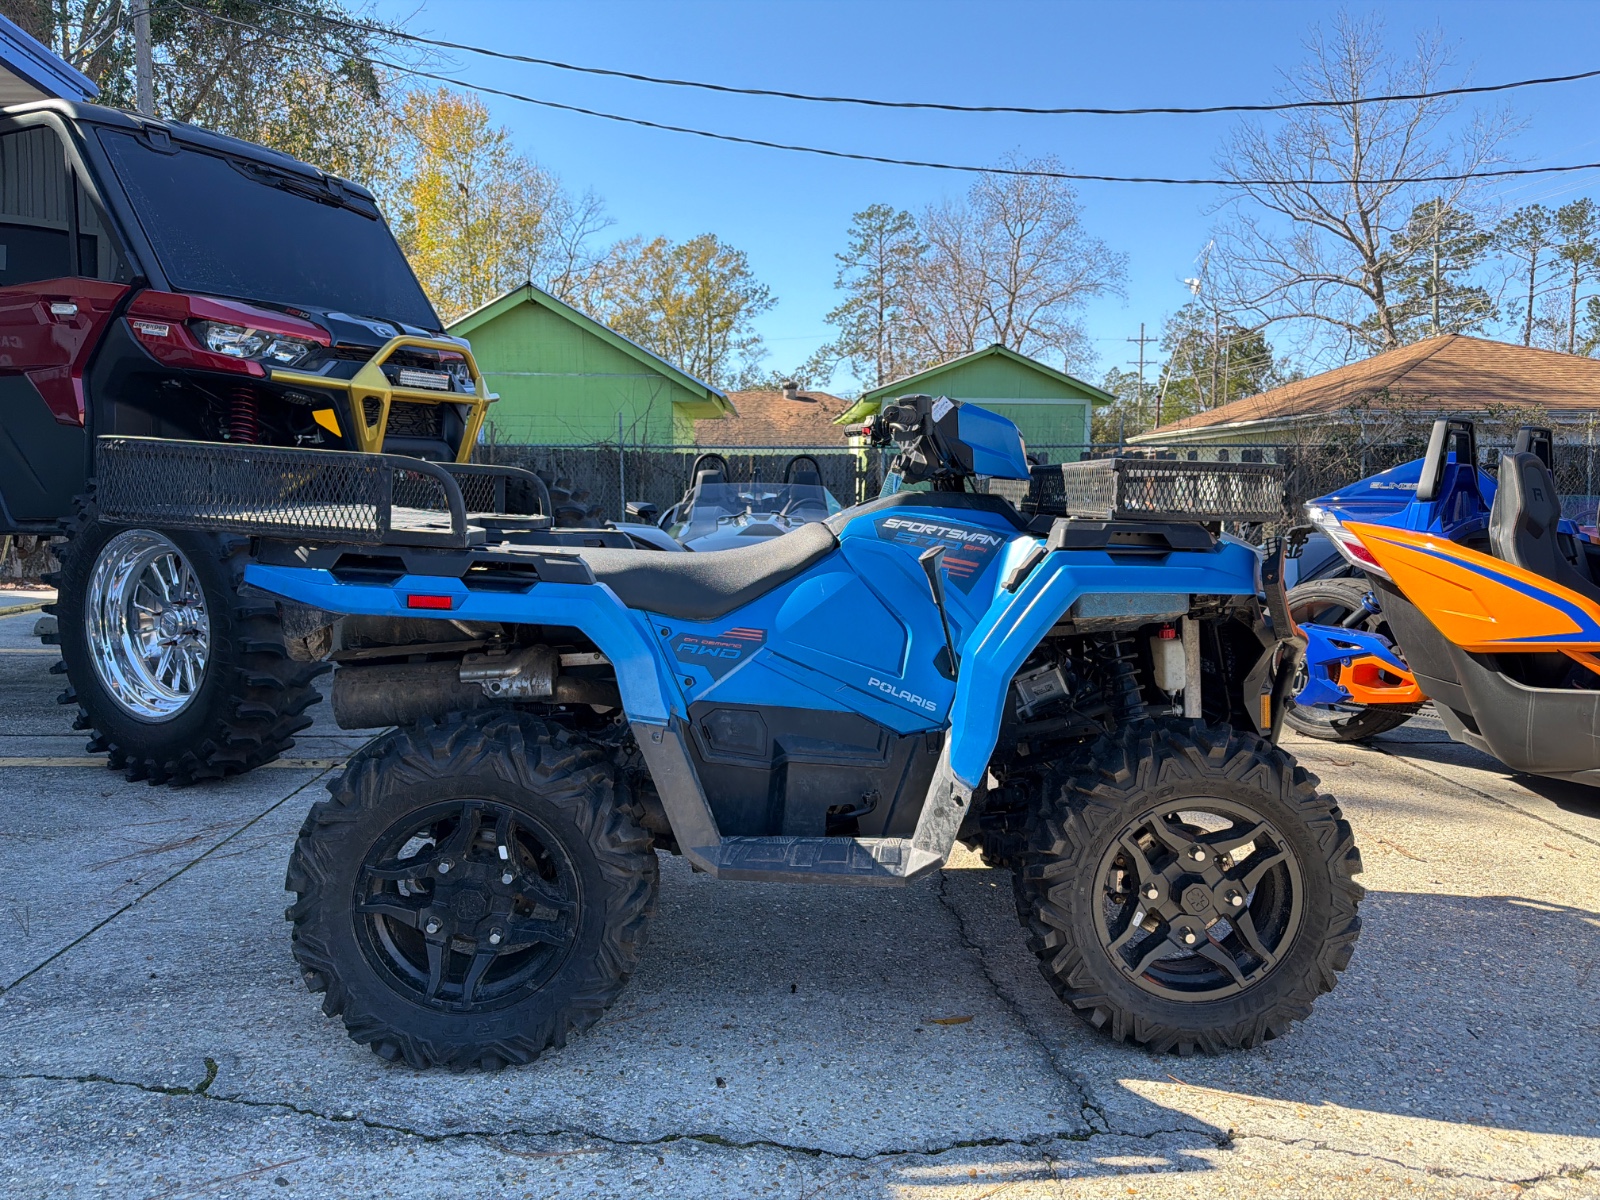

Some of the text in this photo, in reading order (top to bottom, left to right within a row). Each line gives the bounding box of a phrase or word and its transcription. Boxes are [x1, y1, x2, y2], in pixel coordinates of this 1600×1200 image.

[134, 321, 168, 331] DEFENDER
[882, 518, 1001, 546] SPORTSMAN
[894, 532, 962, 551] 570
[676, 643, 742, 659] AWD
[701, 639, 742, 649] DEMAND
[867, 676, 937, 712] POLARIS
